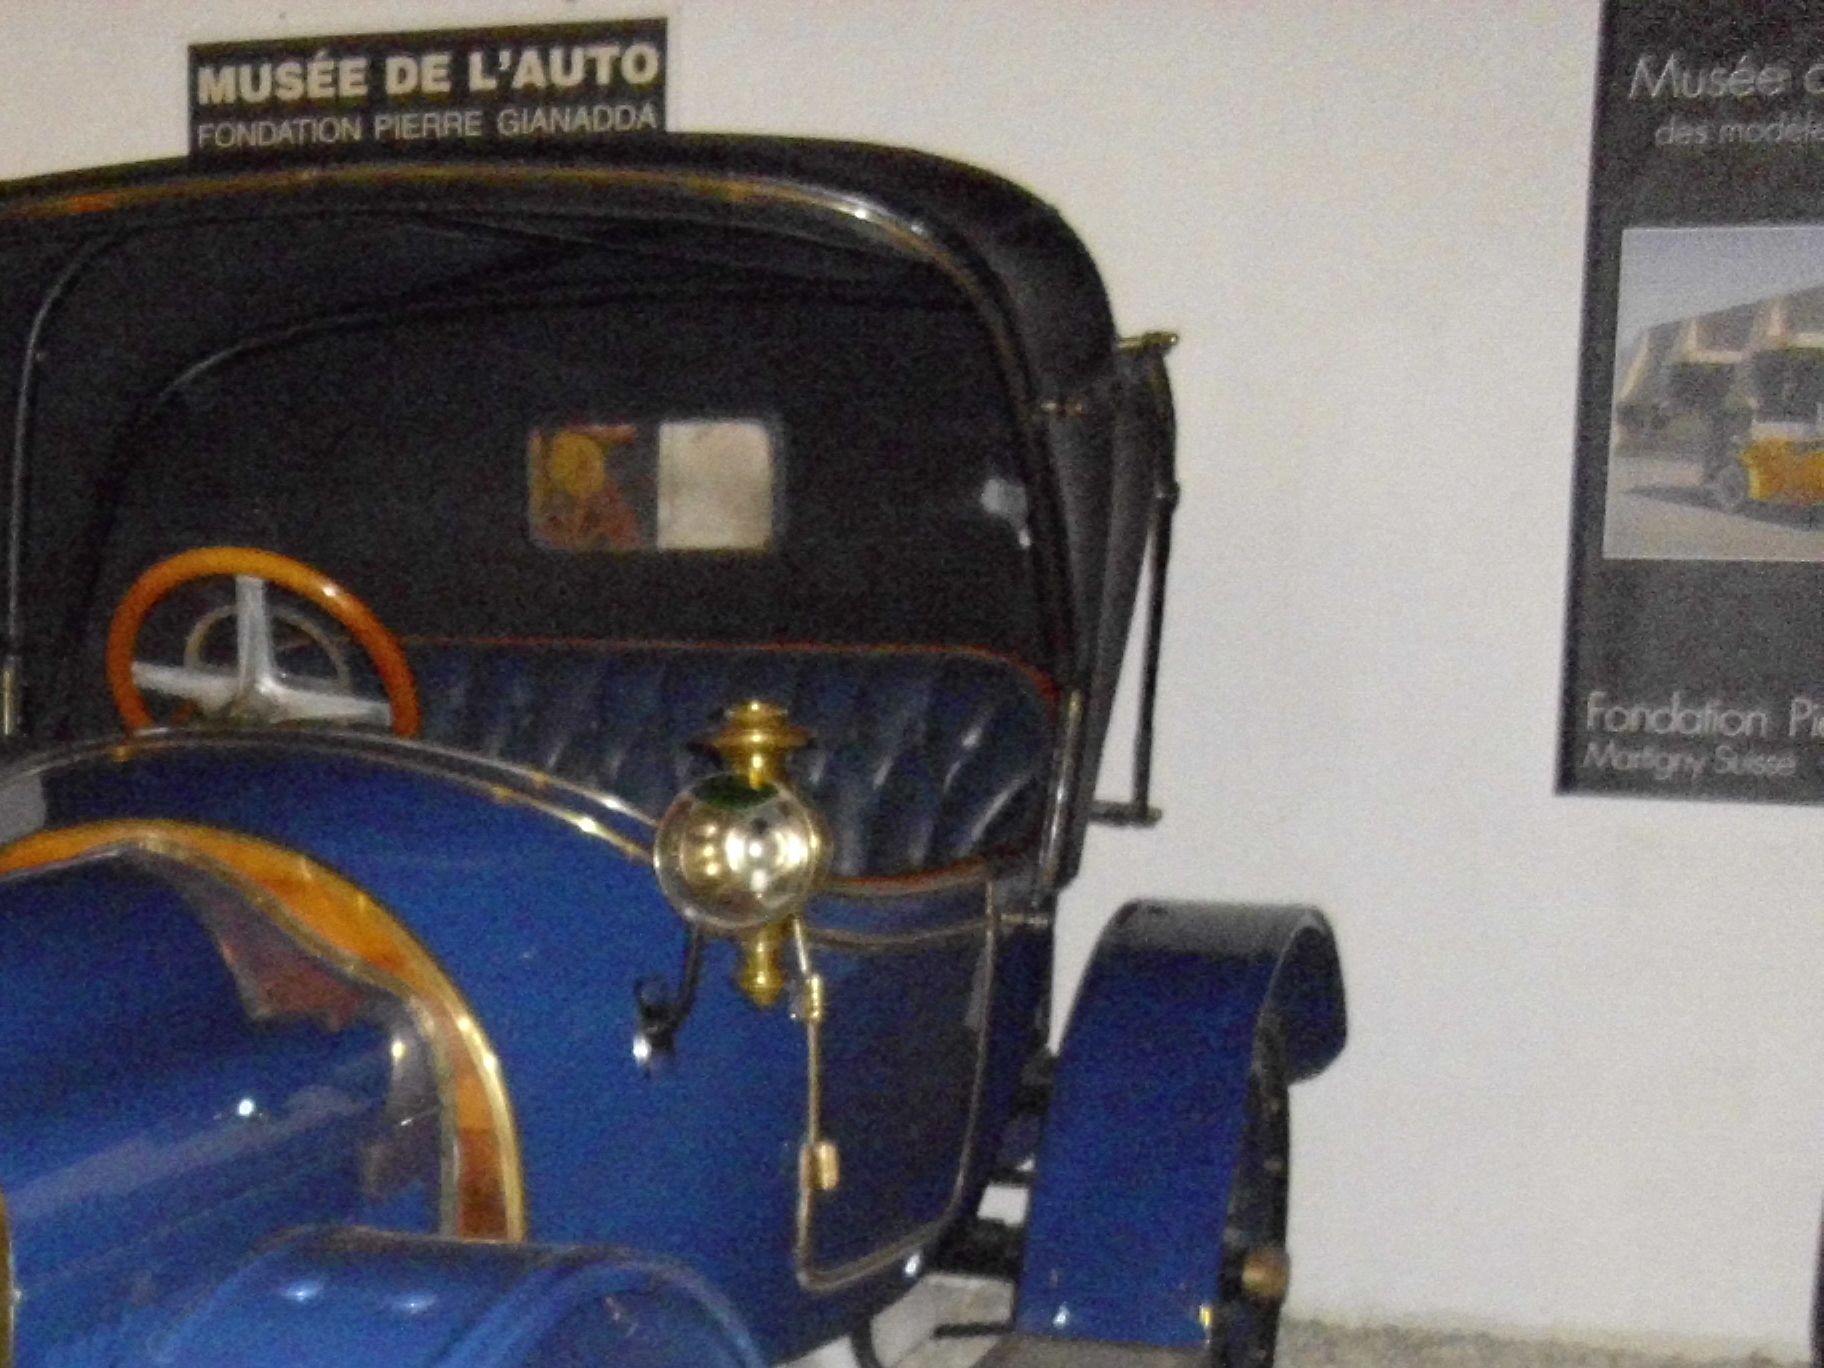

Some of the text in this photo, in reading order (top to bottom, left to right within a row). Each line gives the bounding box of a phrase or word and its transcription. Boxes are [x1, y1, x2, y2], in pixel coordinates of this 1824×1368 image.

[197, 48, 368, 104] MUSÉE
[385, 54, 452, 95] DE
[1628, 54, 1792, 97] Musée
[197, 103, 658, 148] FONDATION PIERRE GIANADDA
[1587, 691, 1769, 738] Fondation
